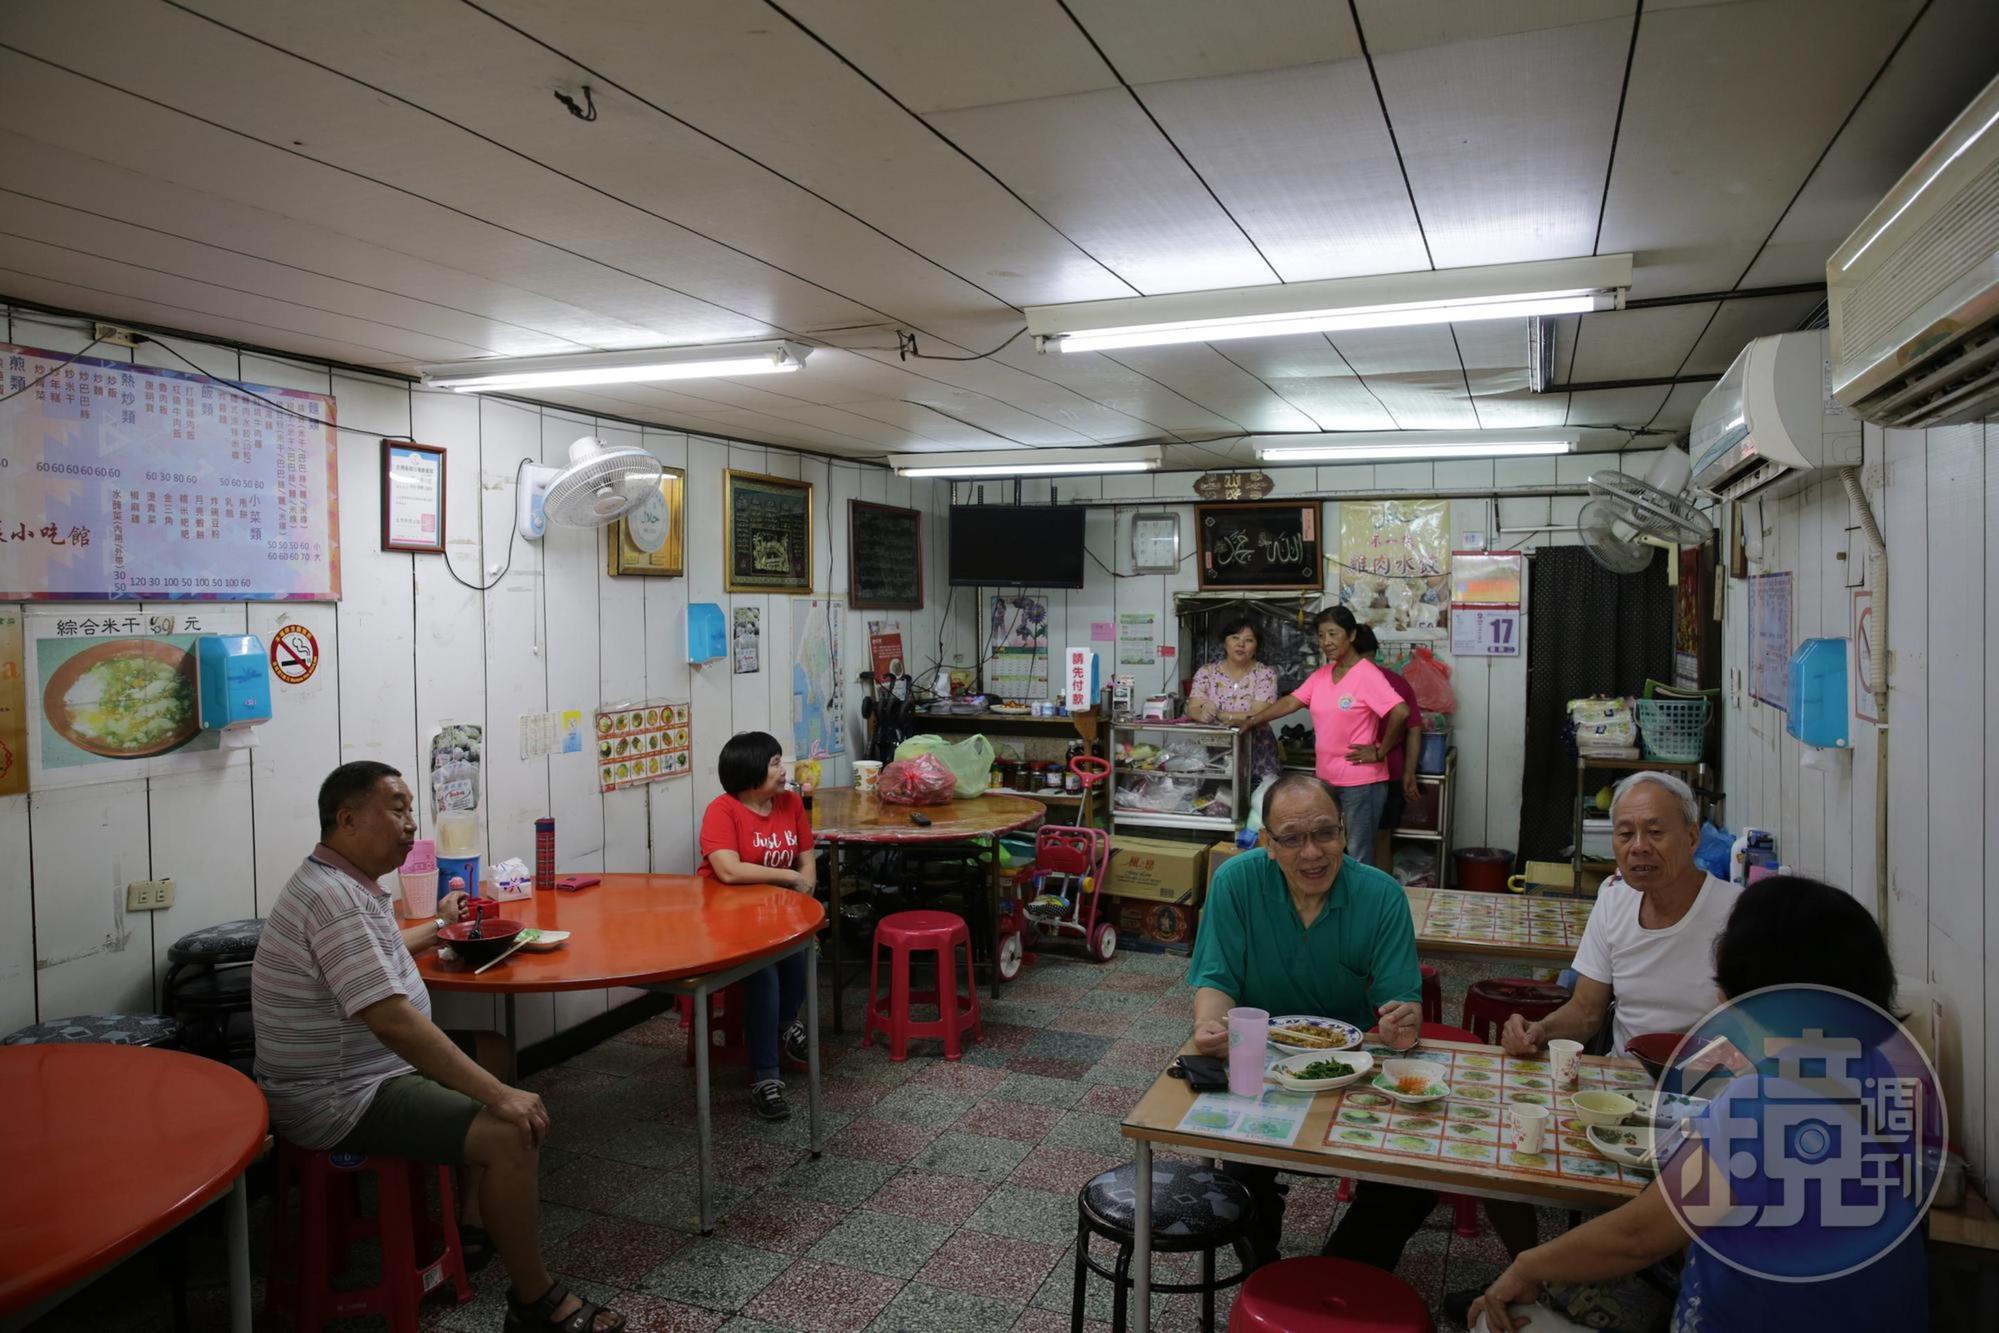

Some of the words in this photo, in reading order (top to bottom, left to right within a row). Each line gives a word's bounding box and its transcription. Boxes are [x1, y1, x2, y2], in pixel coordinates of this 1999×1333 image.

[107, 376, 118, 398] 炒飯
[121, 374, 136, 425] 熱炒類
[201, 384, 215, 416] 飯類
[36, 463, 50, 472] 60
[51, 464, 64, 473] 60
[66, 465, 79, 474] 60
[80, 466, 93, 476] 60
[94, 468, 107, 477] 60
[108, 469, 121, 478] 60
[146, 471, 157, 481] 60
[160, 472, 171, 481] 30
[186, 475, 198, 484] 60
[249, 494, 262, 541] 小菜類
[113, 571, 126, 580] 30
[130, 577, 146, 587] 120
[149, 577, 160, 587] 30
[164, 578, 179, 588] 100
[180, 578, 192, 588] 50
[195, 578, 210, 588] 100
[212, 578, 223, 588] 50
[225, 579, 239, 588] 100
[115, 582, 126, 592] 50
[57, 618, 140, 636] 綜合米干
[184, 616, 202, 632] 元
[1490, 618, 1513, 644] 17
[1072, 652, 1084, 705] 請先付款
[752, 832, 781, 849] Just
